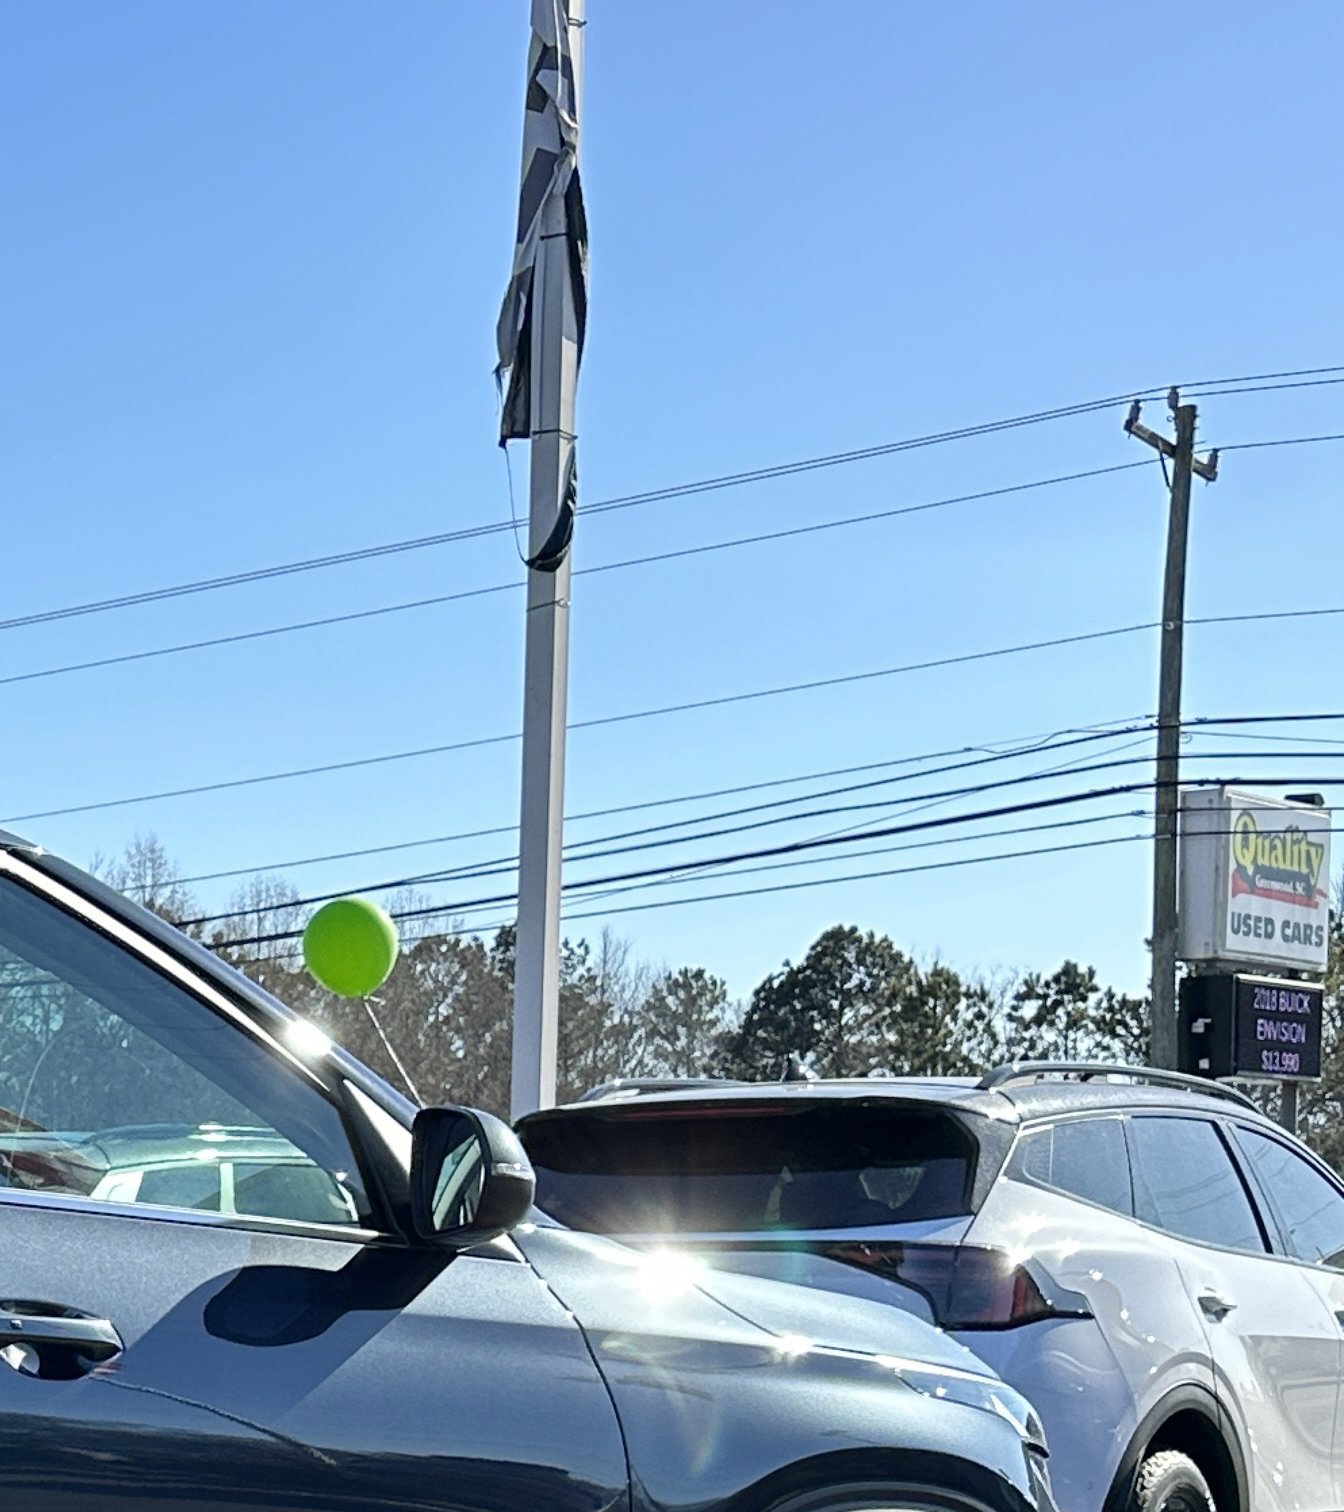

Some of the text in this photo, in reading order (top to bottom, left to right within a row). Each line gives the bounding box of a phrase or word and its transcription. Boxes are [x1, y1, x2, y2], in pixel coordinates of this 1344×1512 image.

[1233, 811, 1324, 890] Quality
[1231, 911, 1324, 947] USED CARS
[1279, 990, 1311, 1014] BUICK
[1256, 1018, 1306, 1043] ENVISION
